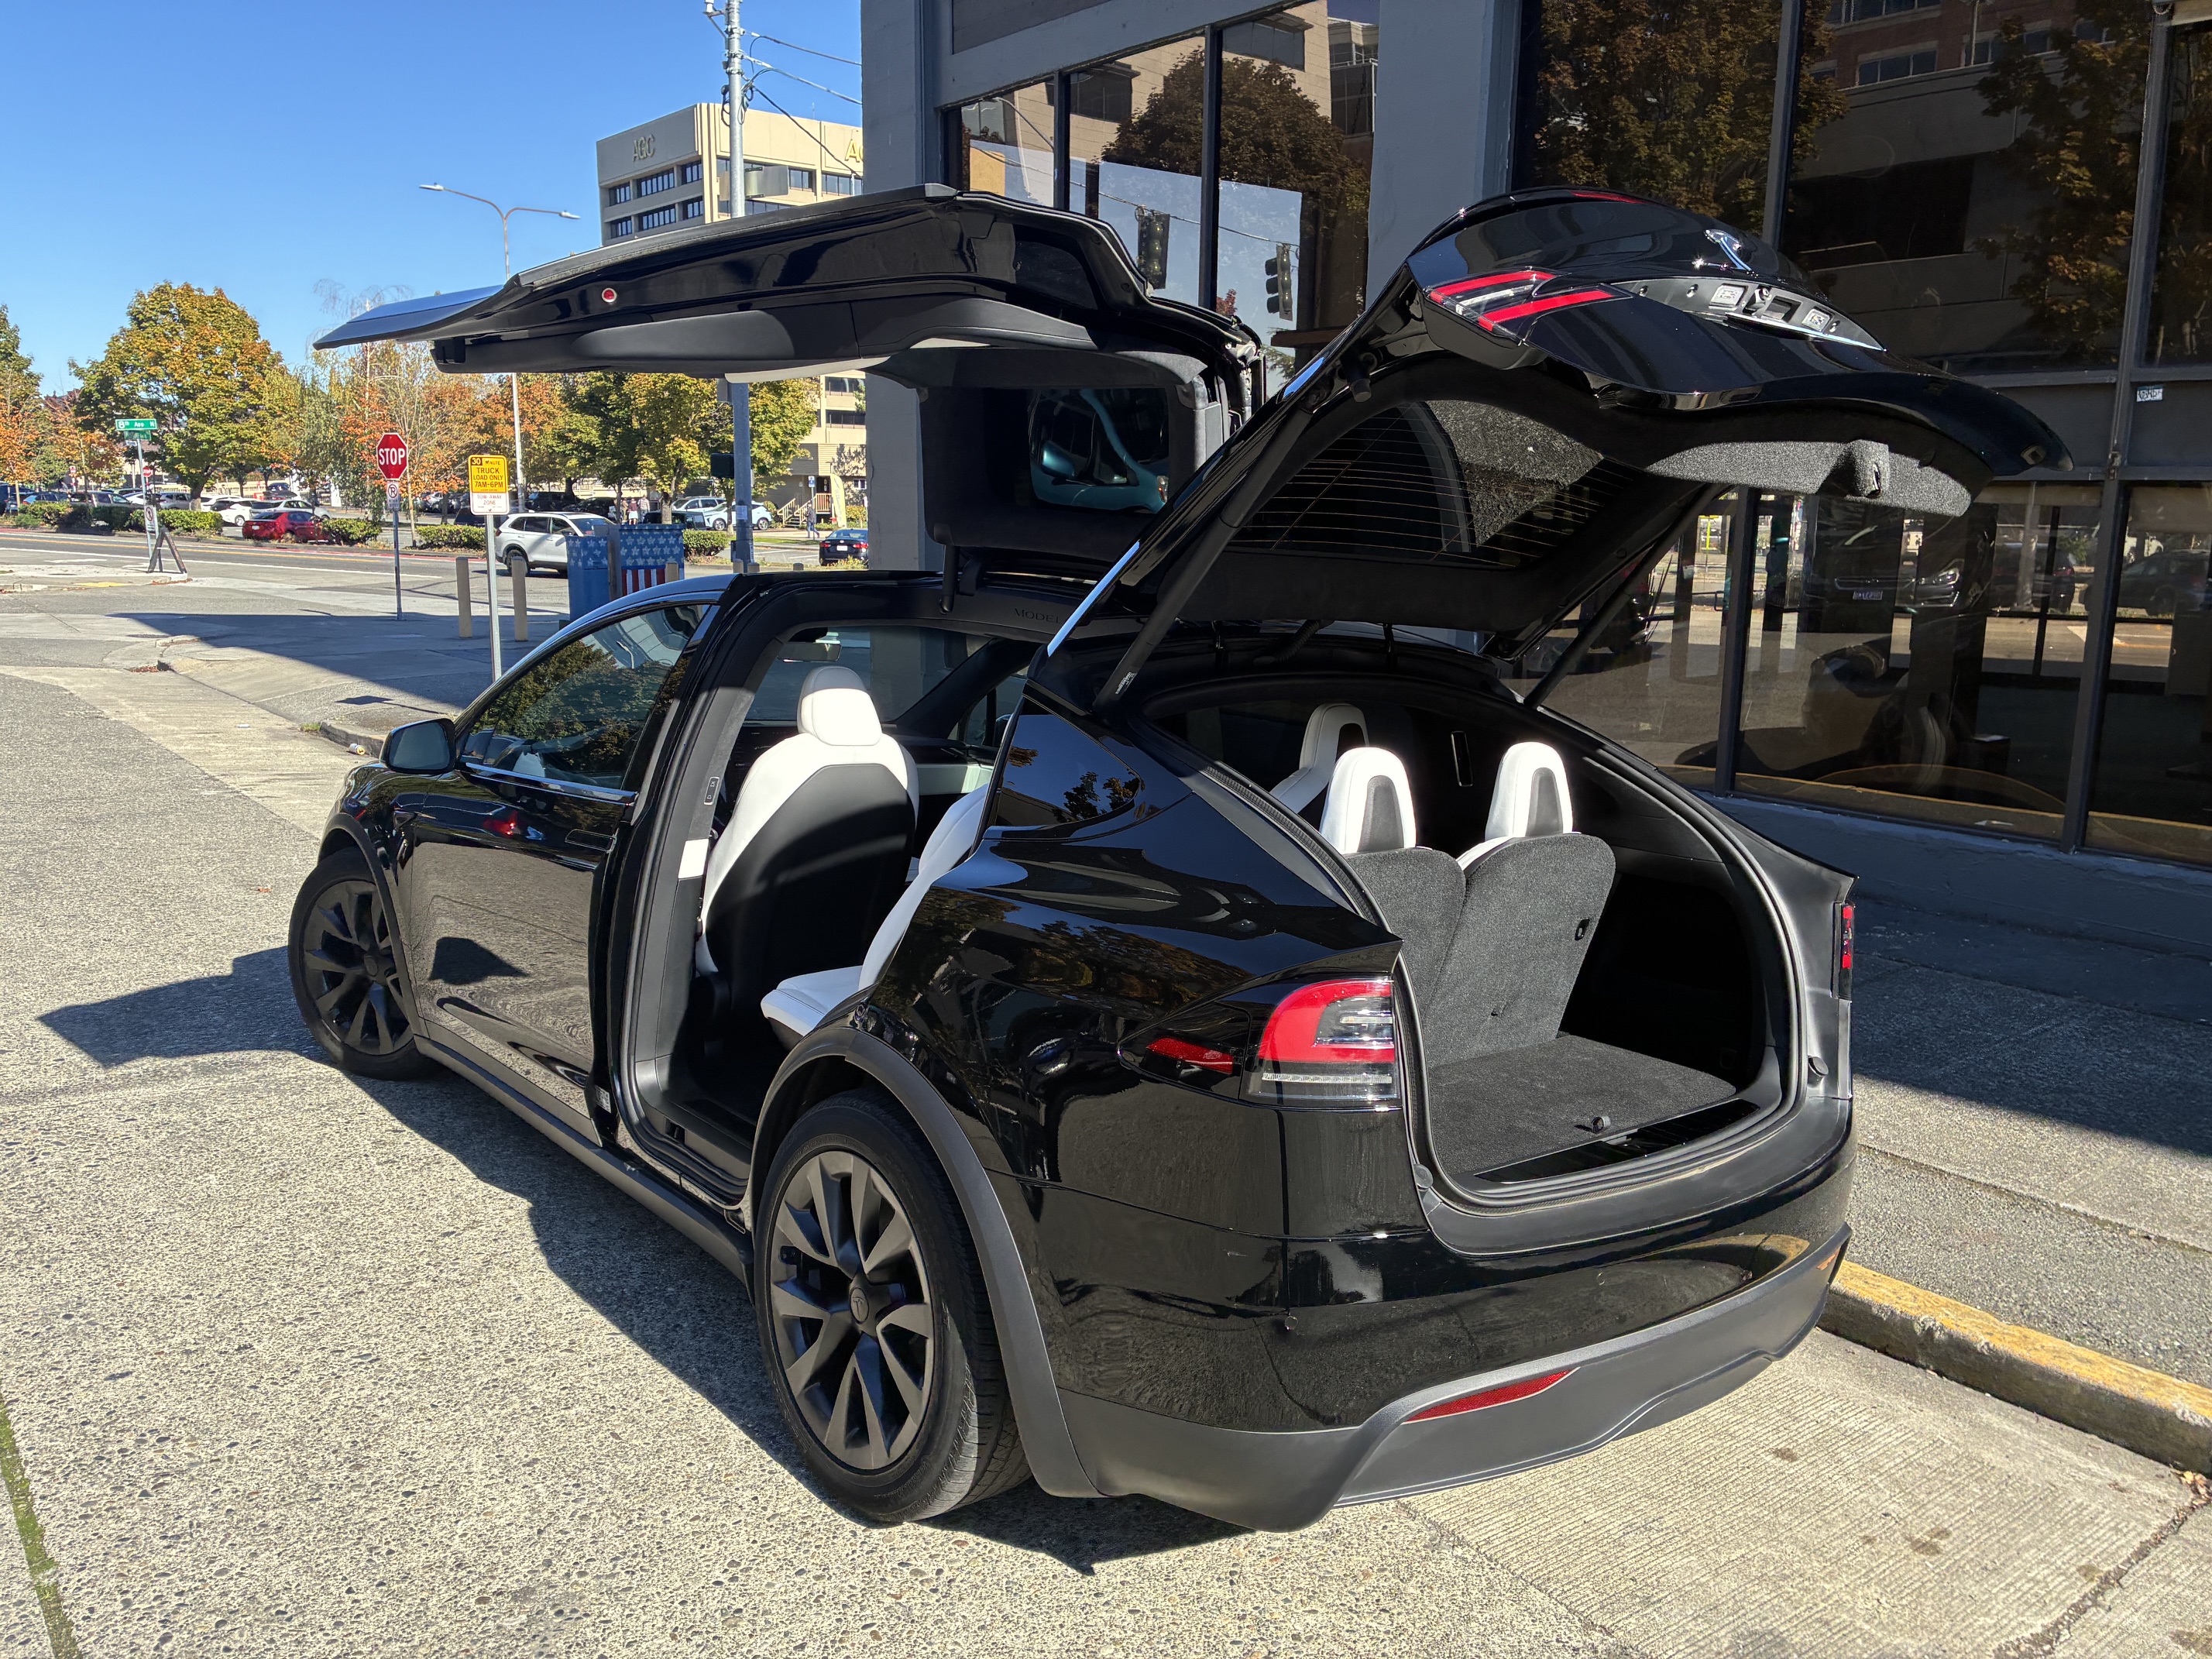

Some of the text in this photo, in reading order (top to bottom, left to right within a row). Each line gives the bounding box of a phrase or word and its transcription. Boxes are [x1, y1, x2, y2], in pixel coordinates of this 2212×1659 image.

[632, 134, 655, 162] AGC
[379, 448, 405, 465] STOP
[1015, 608, 1061, 624] MODEL
